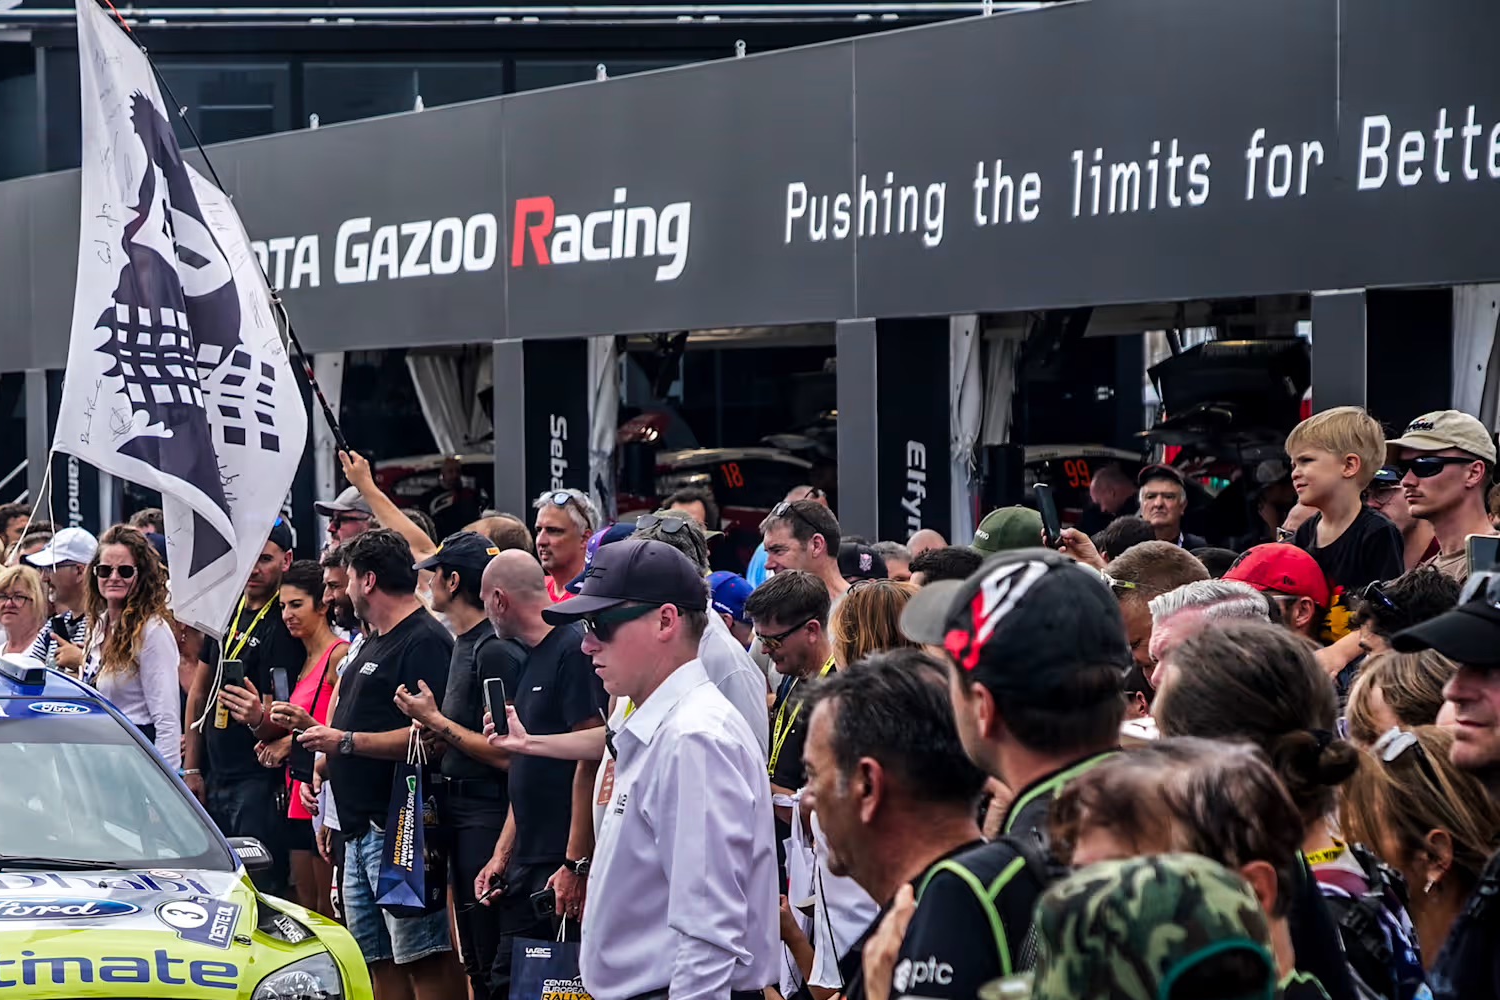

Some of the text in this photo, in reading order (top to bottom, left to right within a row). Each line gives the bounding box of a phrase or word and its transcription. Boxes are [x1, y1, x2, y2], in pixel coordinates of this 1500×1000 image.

[784, 171, 947, 248] Pushing
[973, 159, 1042, 226] the
[1071, 138, 1212, 217] limits
[1245, 128, 1325, 200] for
[333, 212, 498, 284] GAZOO
[510, 187, 691, 282] Racing
[721, 463, 744, 488] 18
[1064, 459, 1092, 488] 99
[166, 908, 205, 921] 3
[273, 916, 304, 945] SPORT
[542, 986, 588, 994] EUROPEA
[543, 978, 583, 987] CENTRAL
